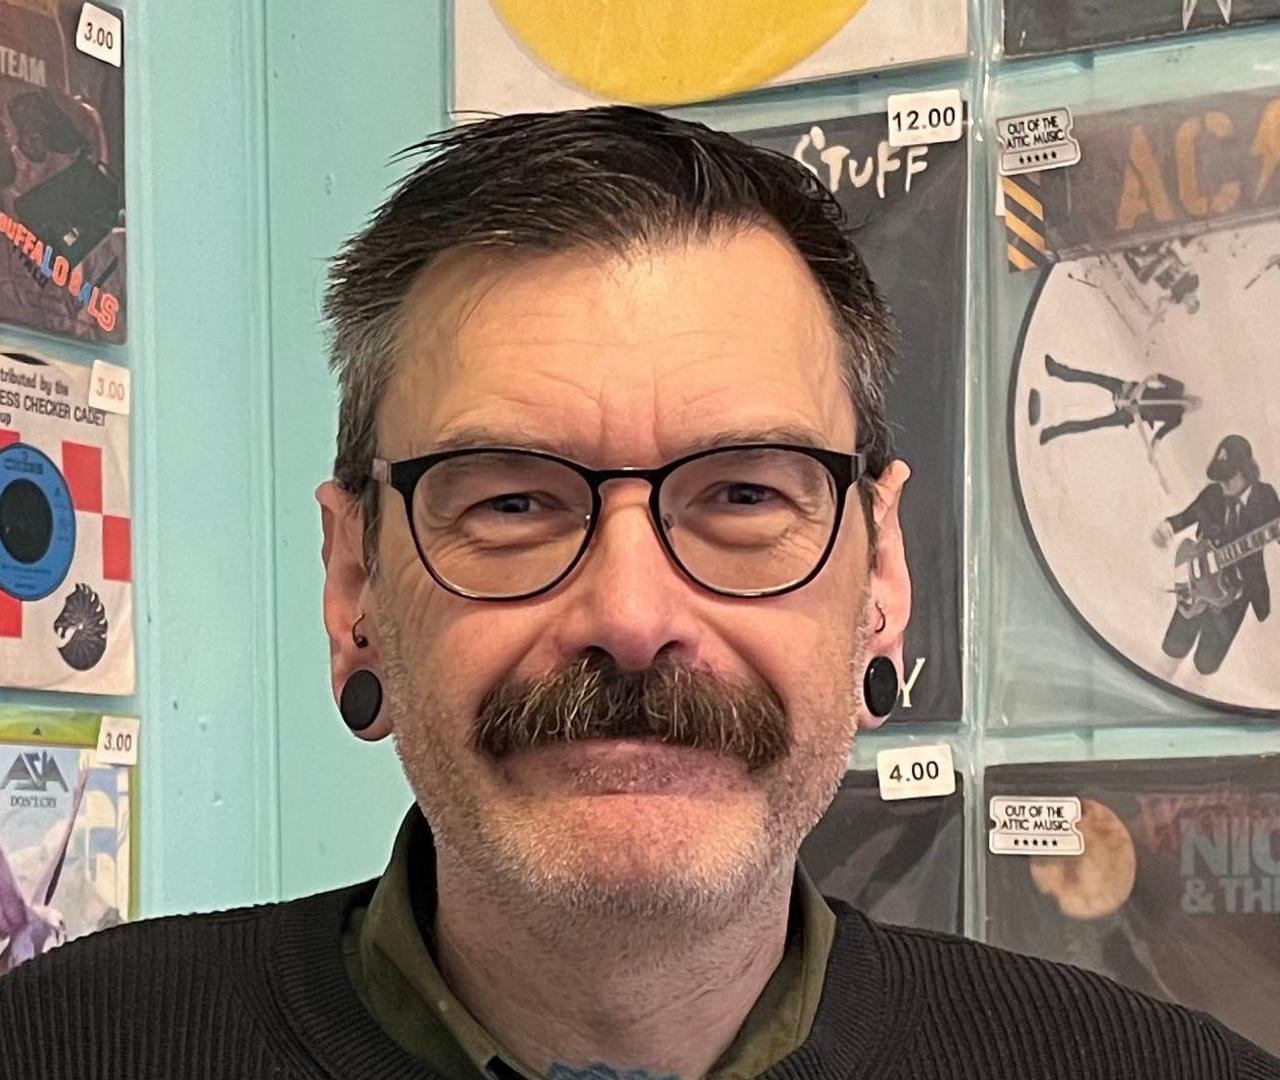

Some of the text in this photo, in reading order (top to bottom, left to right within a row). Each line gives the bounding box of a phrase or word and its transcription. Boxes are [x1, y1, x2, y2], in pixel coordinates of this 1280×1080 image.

[84, 22, 114, 50] 3.00
[893, 108, 956, 132] 12.00
[1008, 116, 1058, 134] OUT OF THE
[1007, 129, 1064, 149] ATTIC MUSIC
[793, 127, 929, 199] STUFF
[69, 263, 119, 332] GALS
[40, 376, 53, 396] by
[55, 380, 69, 396] the
[95, 377, 125, 401] 3.00
[23, 395, 71, 419] CHECKER
[73, 406, 106, 427] CADET
[104, 733, 132, 751] 3.00
[889, 760, 940, 783] 4.00
[1004, 805, 1064, 818] OUT OF THE
[1001, 819, 1070, 831] ATTIC MUSIC
[1181, 879, 1215, 913] &
